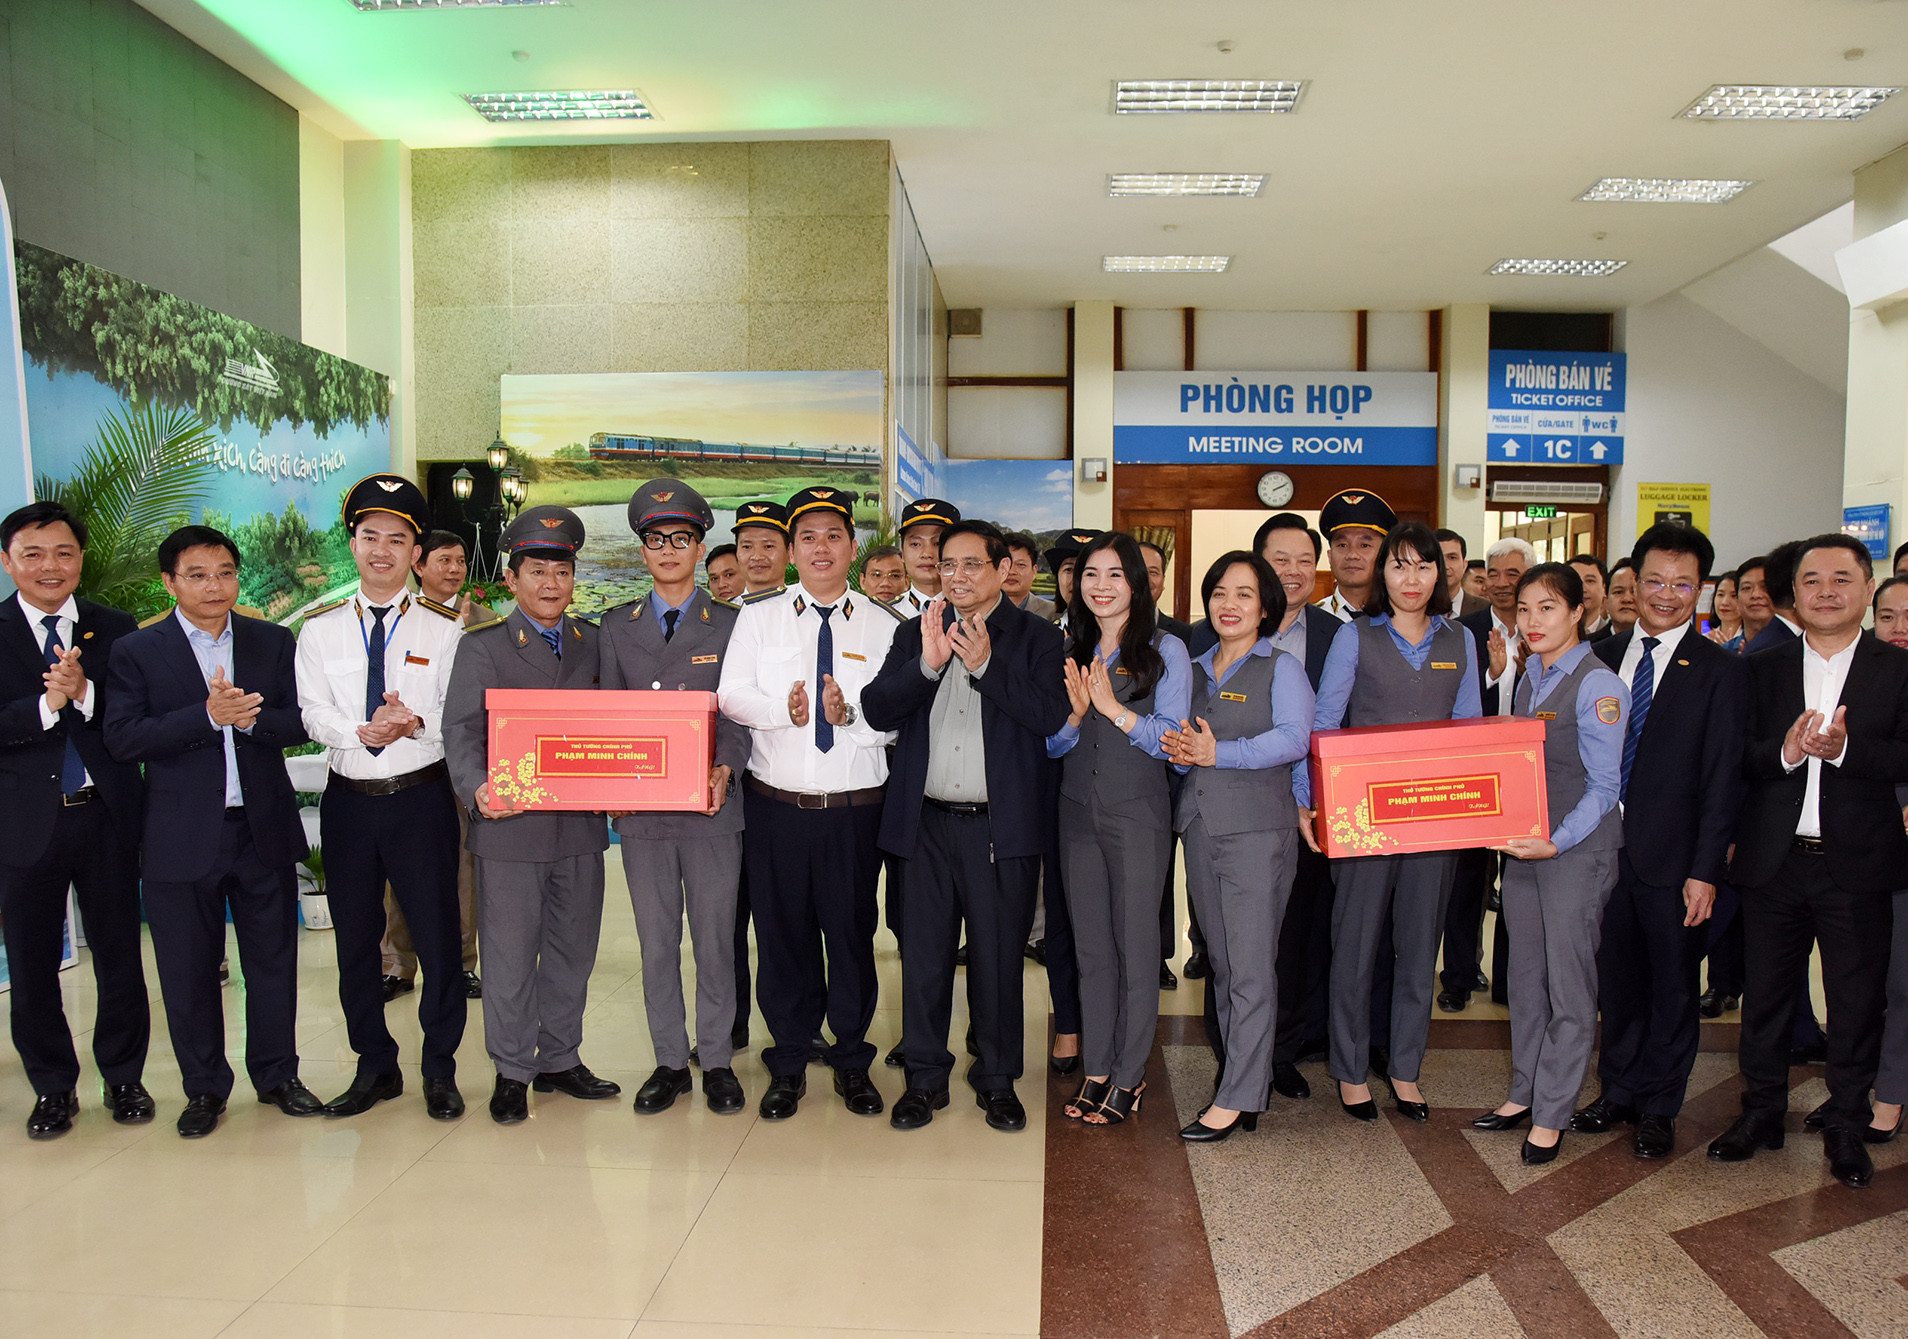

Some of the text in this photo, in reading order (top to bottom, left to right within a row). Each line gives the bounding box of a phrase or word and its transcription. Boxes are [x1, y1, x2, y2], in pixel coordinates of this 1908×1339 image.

[1505, 358, 1613, 391] PHÒNG BÁN VÉ
[1180, 376, 1373, 420] PHÒNG HỌP
[1511, 393, 1603, 407] TICKET OFFICE
[1591, 420, 1609, 430] WC
[1188, 436, 1363, 455] MEETING ROOM
[1543, 438, 1573, 459] 1C
[1640, 493, 1708, 501] LUGGAGE LOCKER
[1527, 505, 1555, 517] EXIT
[555, 751, 648, 761] PHẠM MINH CHÍNH
[1388, 791, 1481, 806] PHẠM MINH CHÍNH
